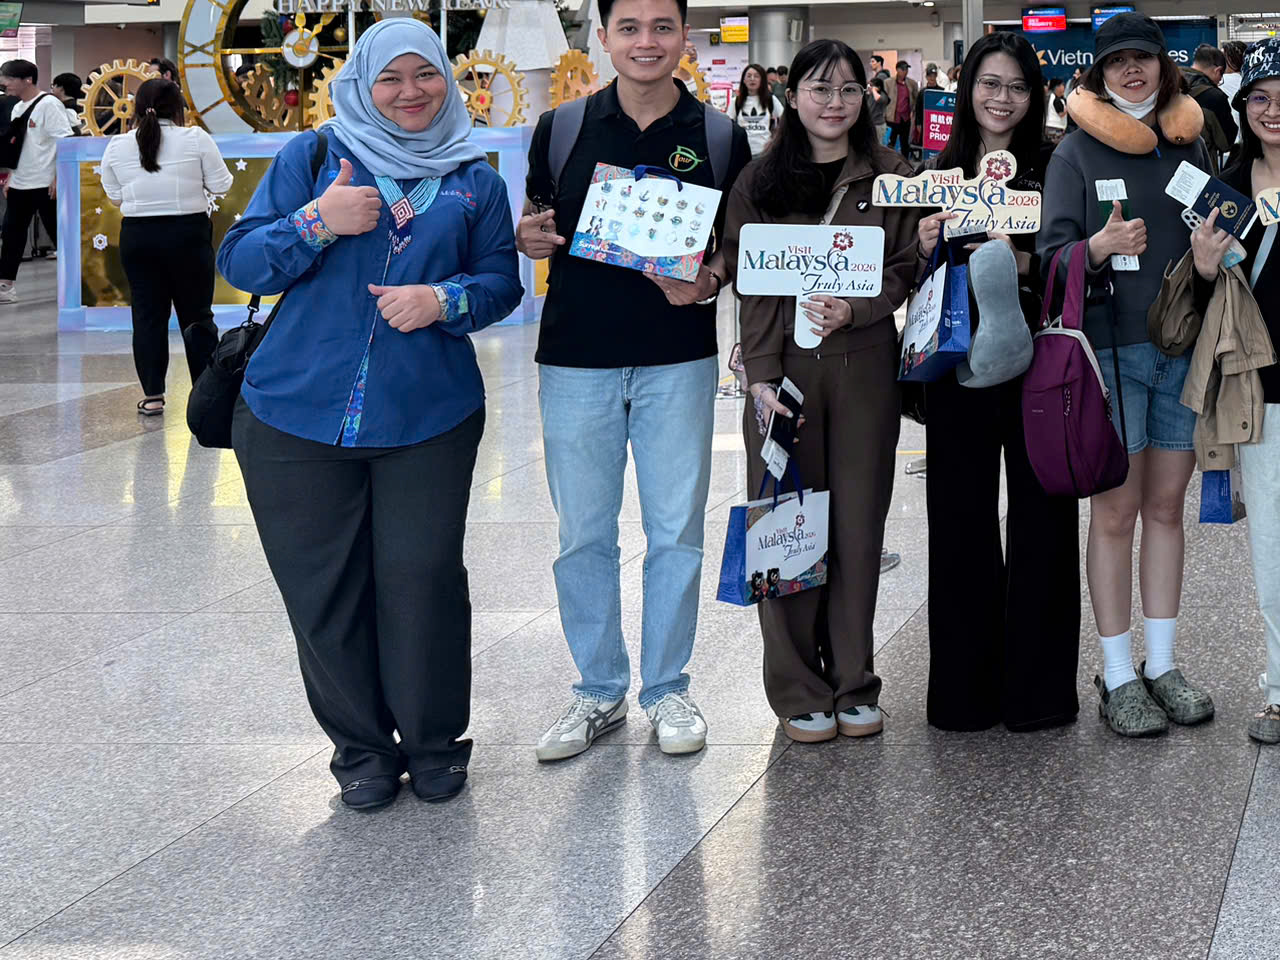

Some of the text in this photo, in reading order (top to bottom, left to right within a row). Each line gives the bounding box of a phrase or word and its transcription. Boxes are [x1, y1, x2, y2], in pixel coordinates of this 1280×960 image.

[929, 123, 940, 132] CZ
[931, 174, 960, 185] Visit
[875, 178, 1039, 210] Malaysia 2026
[1001, 215, 1037, 230] Asia
[788, 245, 812, 254] Visit
[743, 247, 876, 275] Malaysia 2026
[801, 273, 874, 296] Truly Asia
[758, 528, 805, 550] Malaysia
